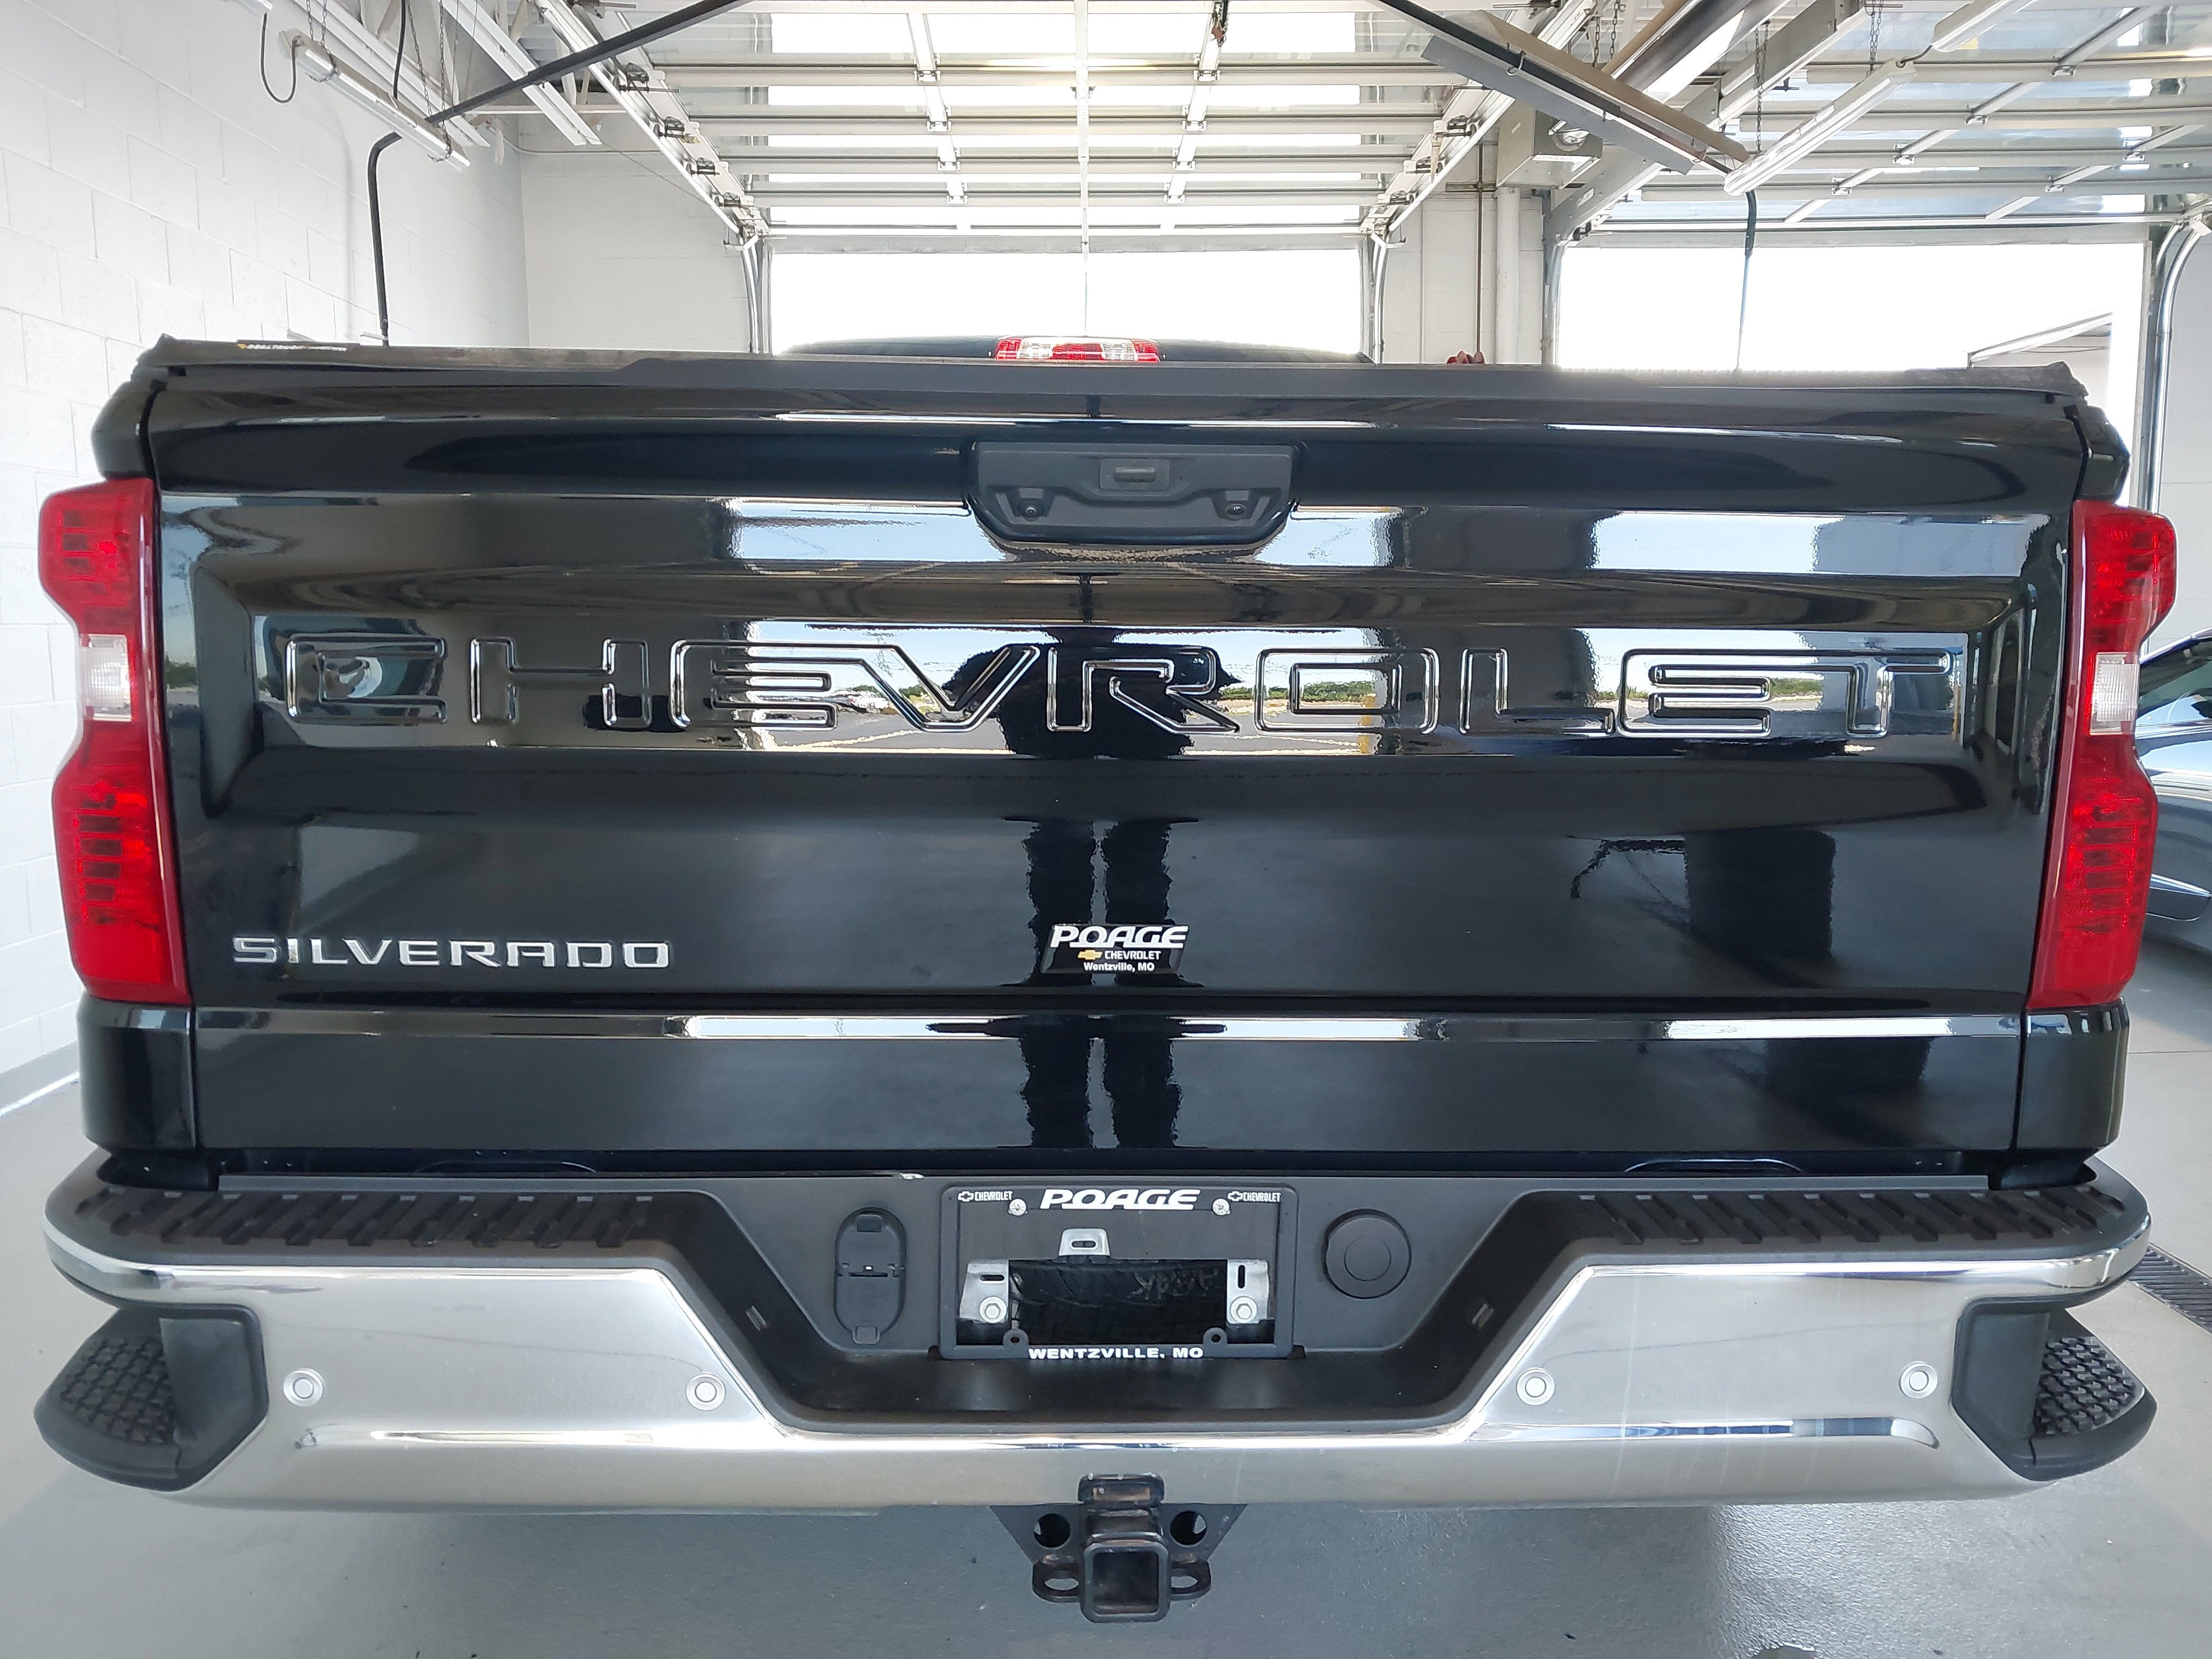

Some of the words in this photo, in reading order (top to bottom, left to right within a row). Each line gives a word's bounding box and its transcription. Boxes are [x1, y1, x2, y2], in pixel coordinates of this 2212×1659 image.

[285, 637, 1952, 738] CHEVROLET
[1050, 925, 1189, 948] POAGE
[232, 936, 670, 969] SILVERADO
[1104, 950, 1162, 960] CHEVROLET
[1083, 962, 1136, 973] Wentzville,
[1137, 962, 1155, 972] MO
[974, 1191, 1013, 1201] CHEVROLET
[1039, 1189, 1201, 1210] POAGE
[1243, 1192, 1282, 1203] CHEVROLET
[1028, 1348, 1165, 1360] WENTZVILLE,
[1172, 1347, 1204, 1359] MO
